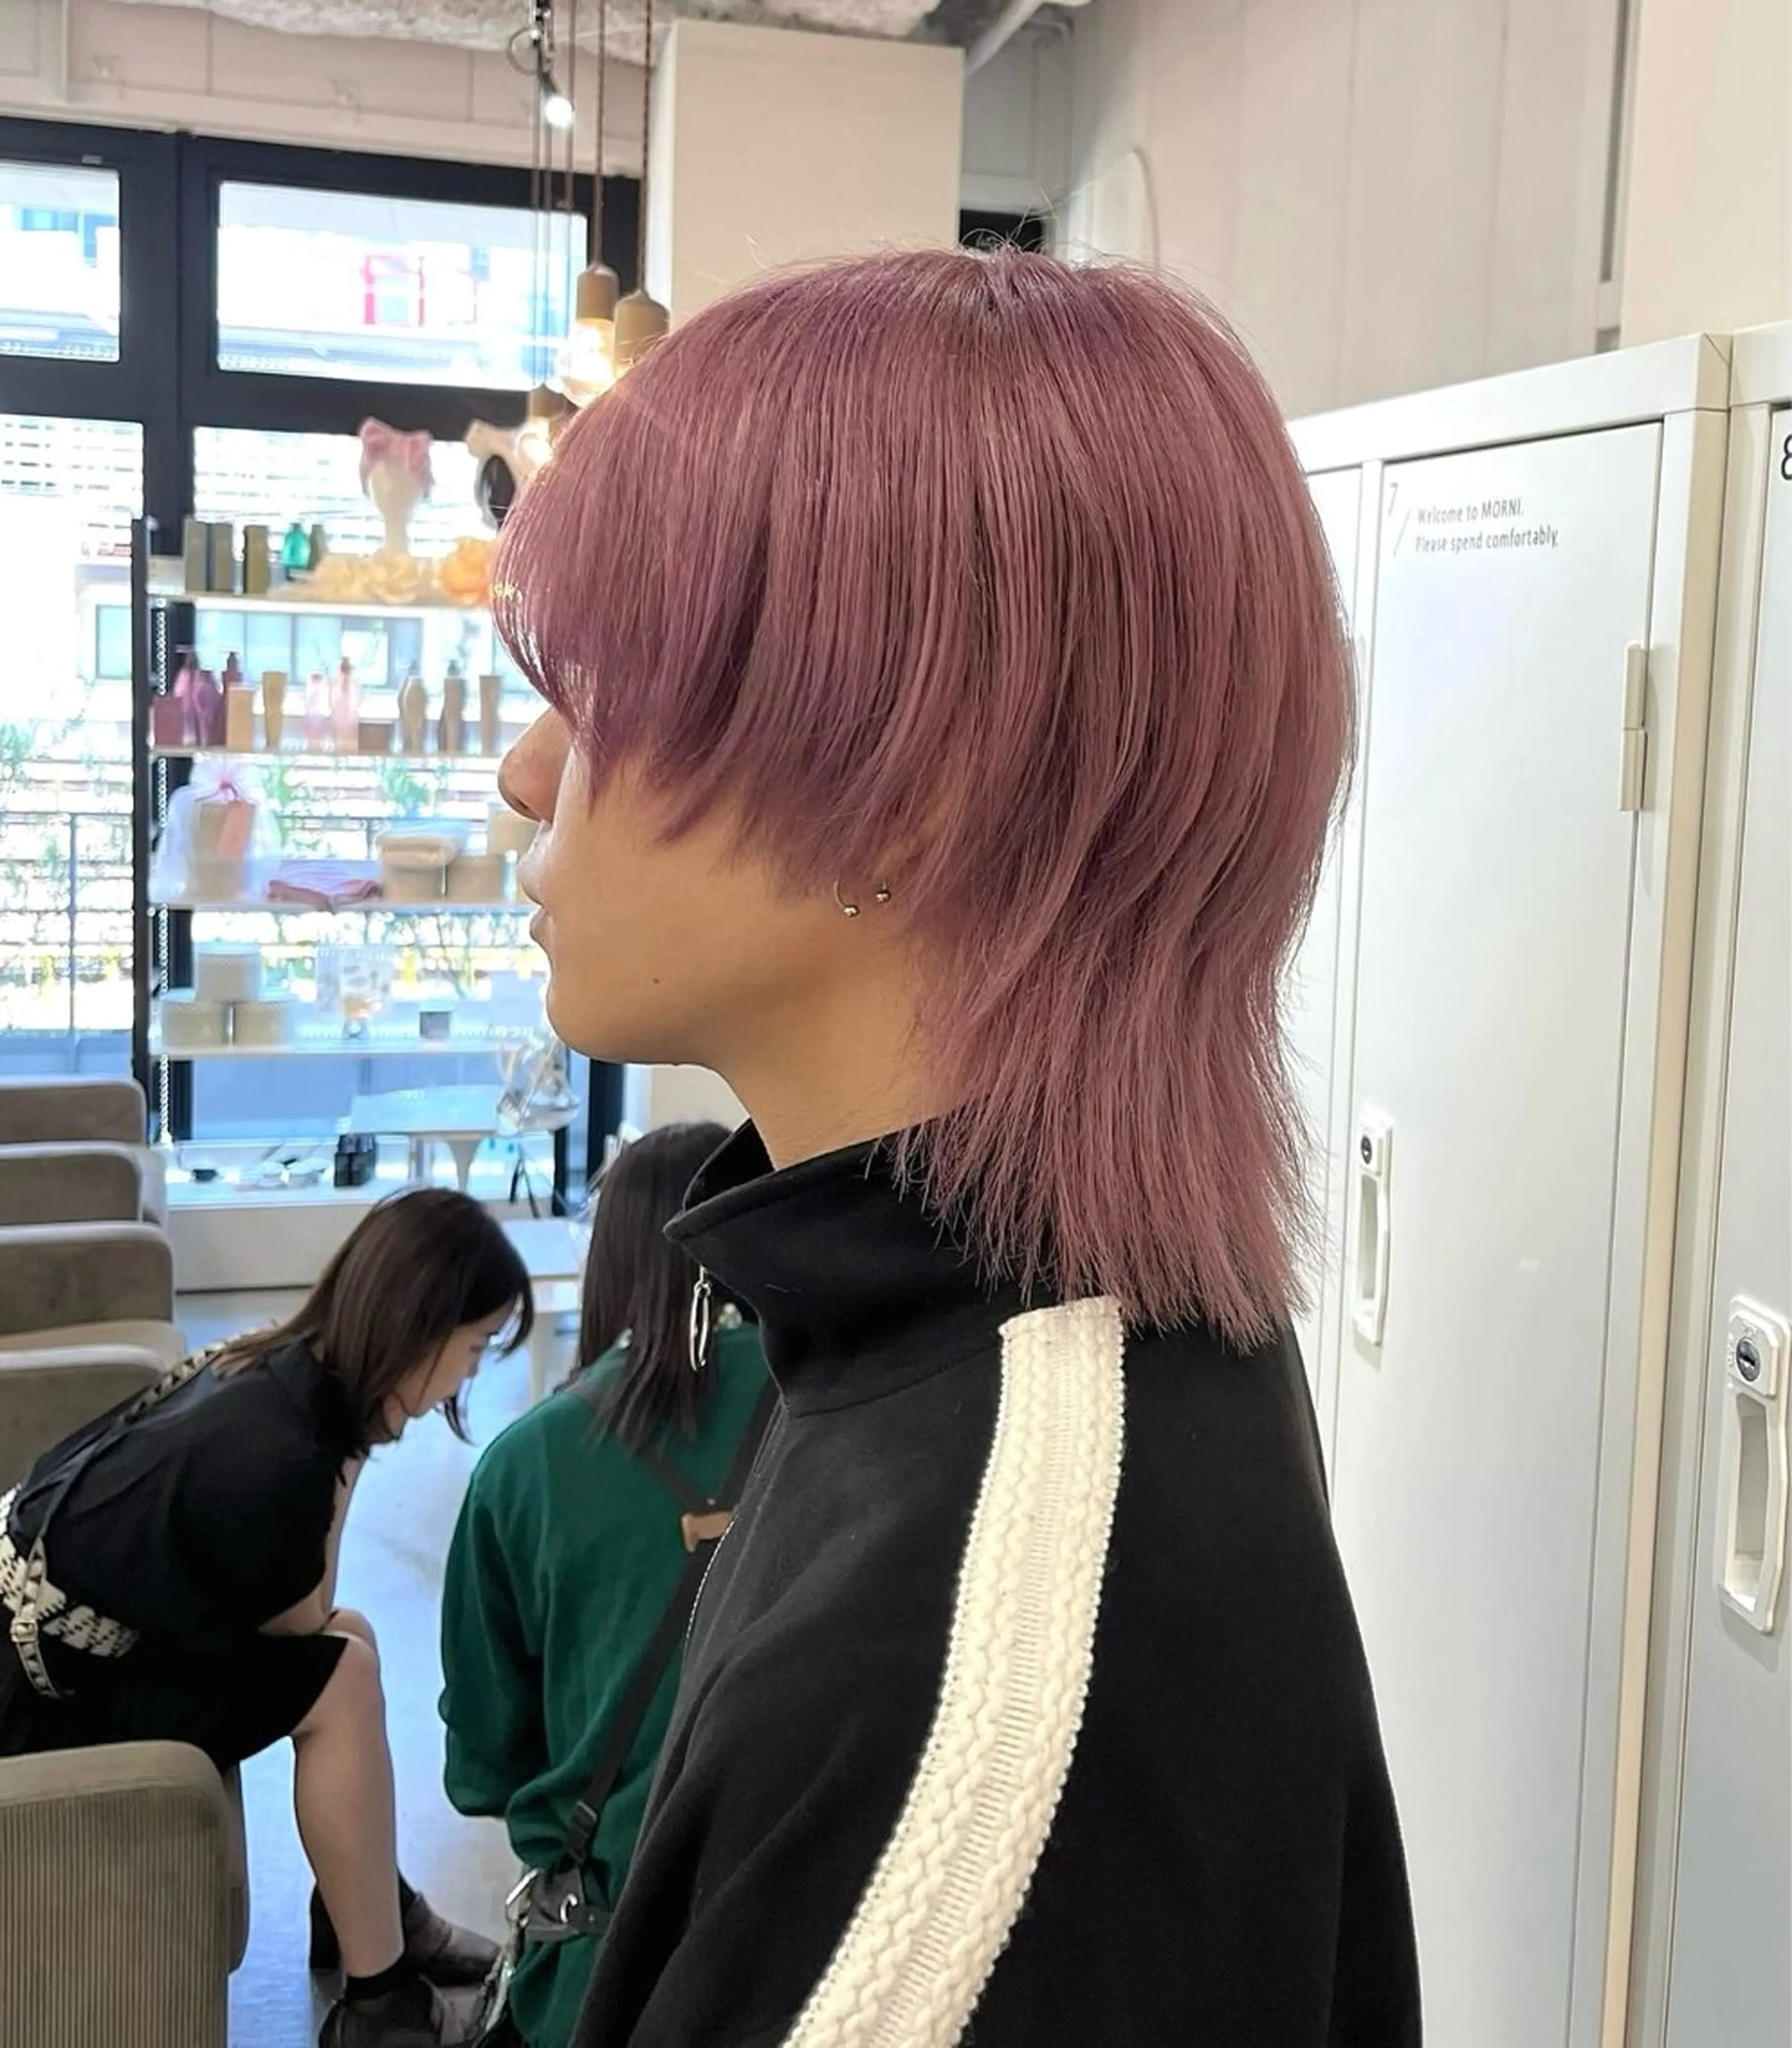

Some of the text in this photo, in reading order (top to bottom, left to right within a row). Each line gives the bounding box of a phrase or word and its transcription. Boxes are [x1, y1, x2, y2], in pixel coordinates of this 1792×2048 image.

[1388, 482, 1399, 517] 7
[1418, 504, 1463, 524] Welcome
[1466, 504, 1478, 522] to
[1415, 524, 1559, 555] Please spend comfortably.
